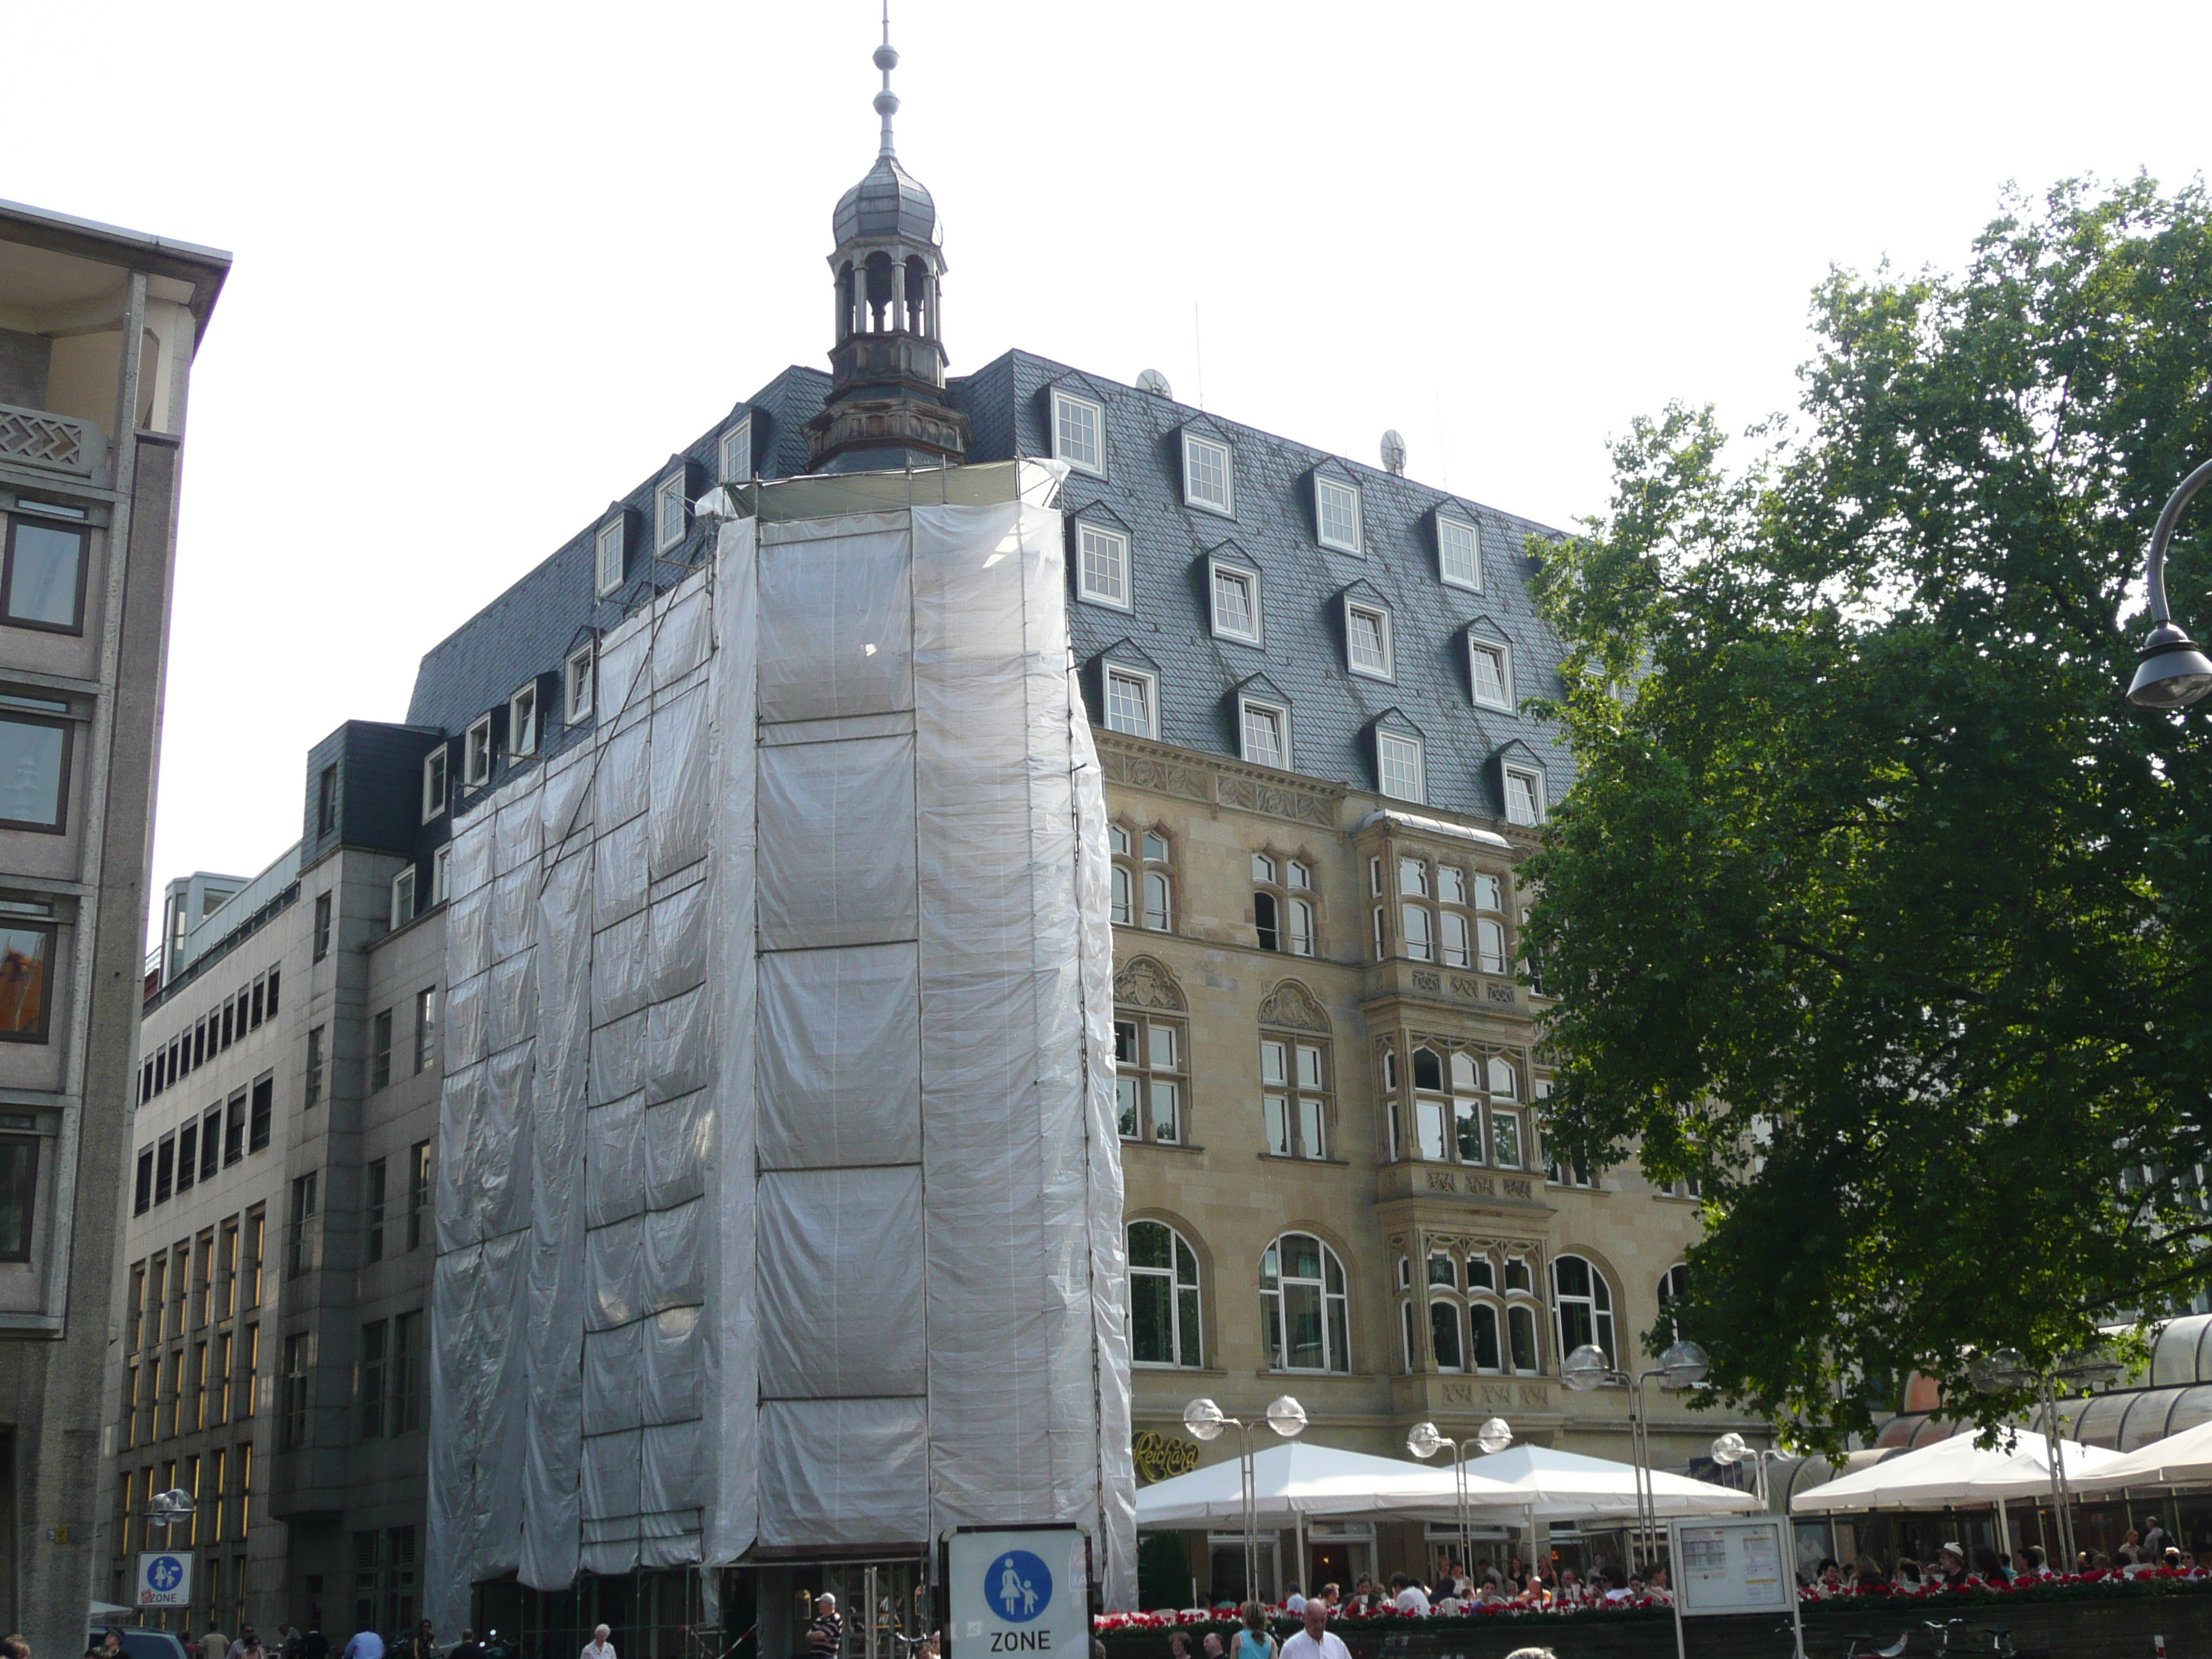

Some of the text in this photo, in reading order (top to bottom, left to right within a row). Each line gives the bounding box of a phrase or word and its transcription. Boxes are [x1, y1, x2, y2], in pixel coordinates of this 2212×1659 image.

[1132, 1430, 1200, 1483] Reichard
[151, 1593, 177, 1603] ZONE
[990, 1630, 1051, 1653] ZONE
